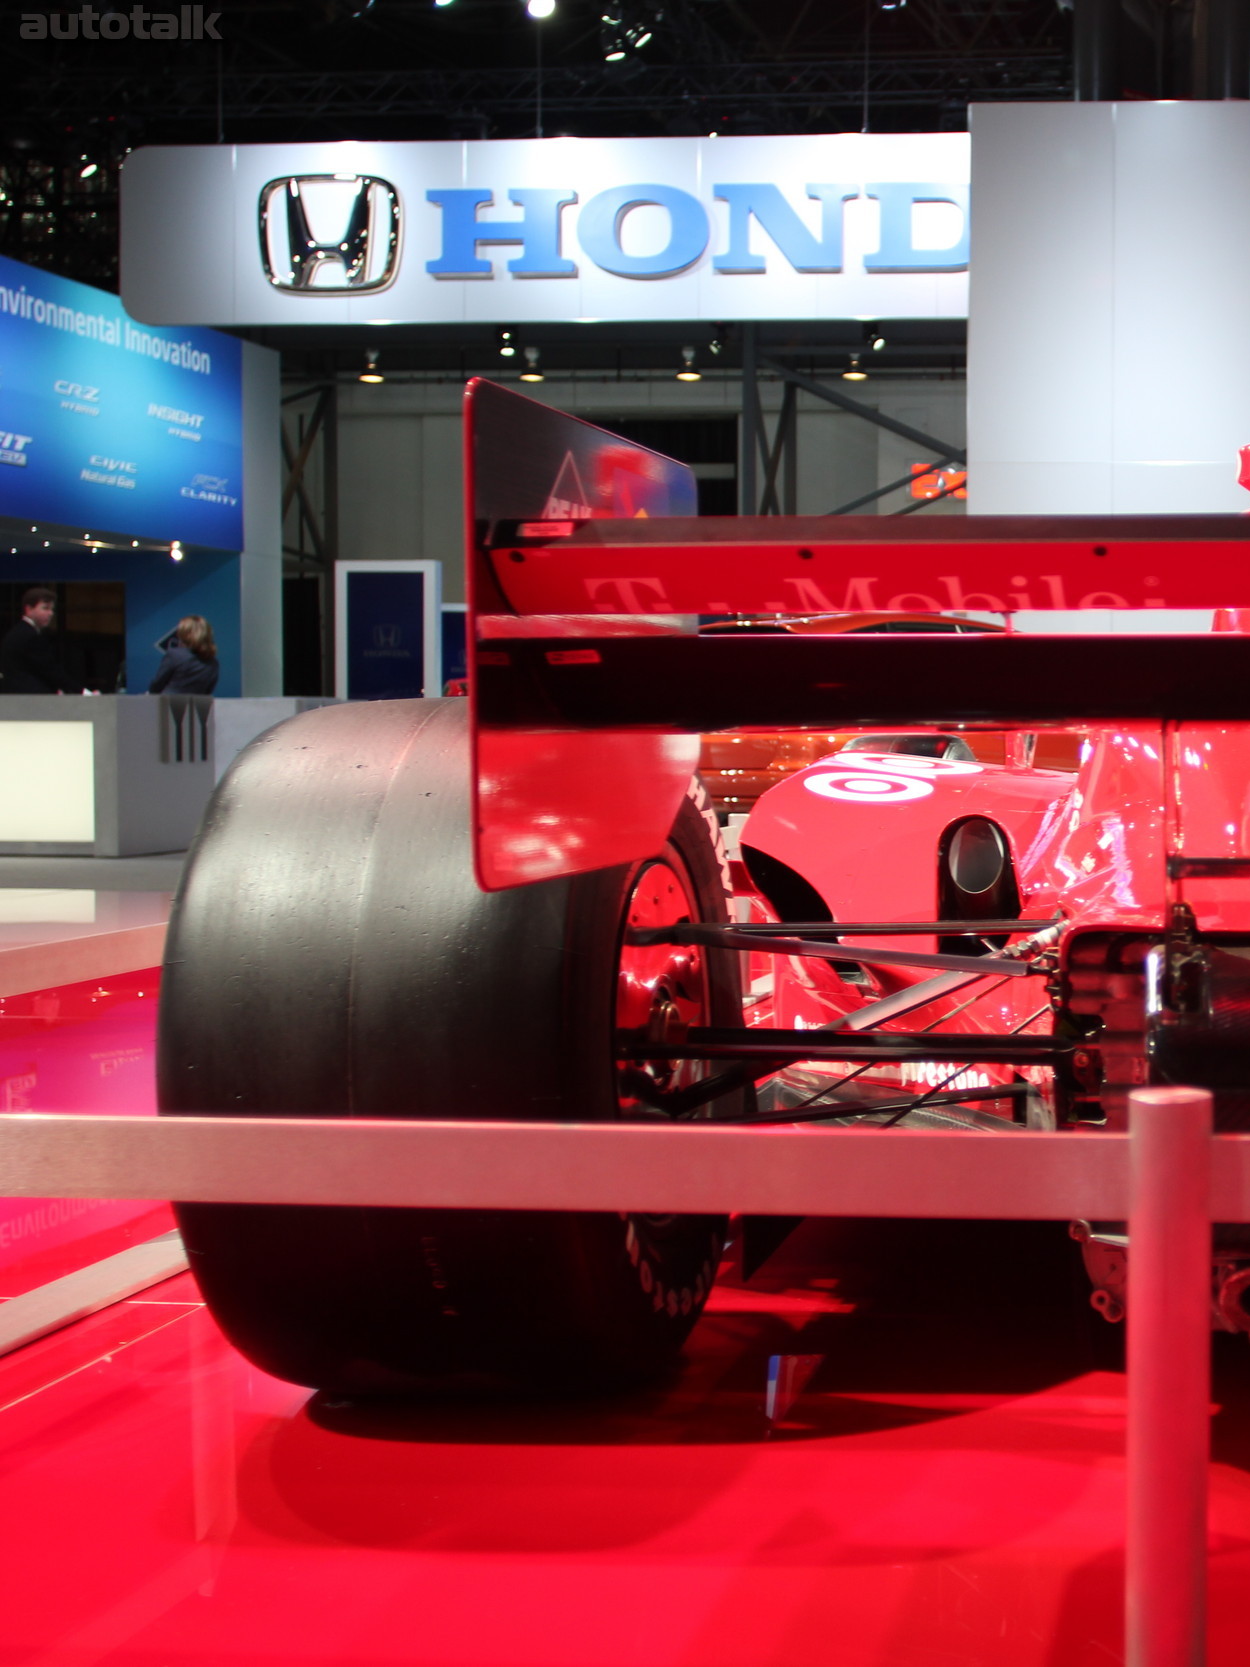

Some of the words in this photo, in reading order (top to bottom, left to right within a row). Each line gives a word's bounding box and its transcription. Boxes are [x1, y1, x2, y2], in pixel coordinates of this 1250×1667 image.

[124, 320, 211, 375] Innovation
[147, 403, 204, 428] INSIGHT
[80, 468, 117, 487] Natural
[117, 475, 136, 489] Gas
[180, 486, 237, 506] CLARITY
